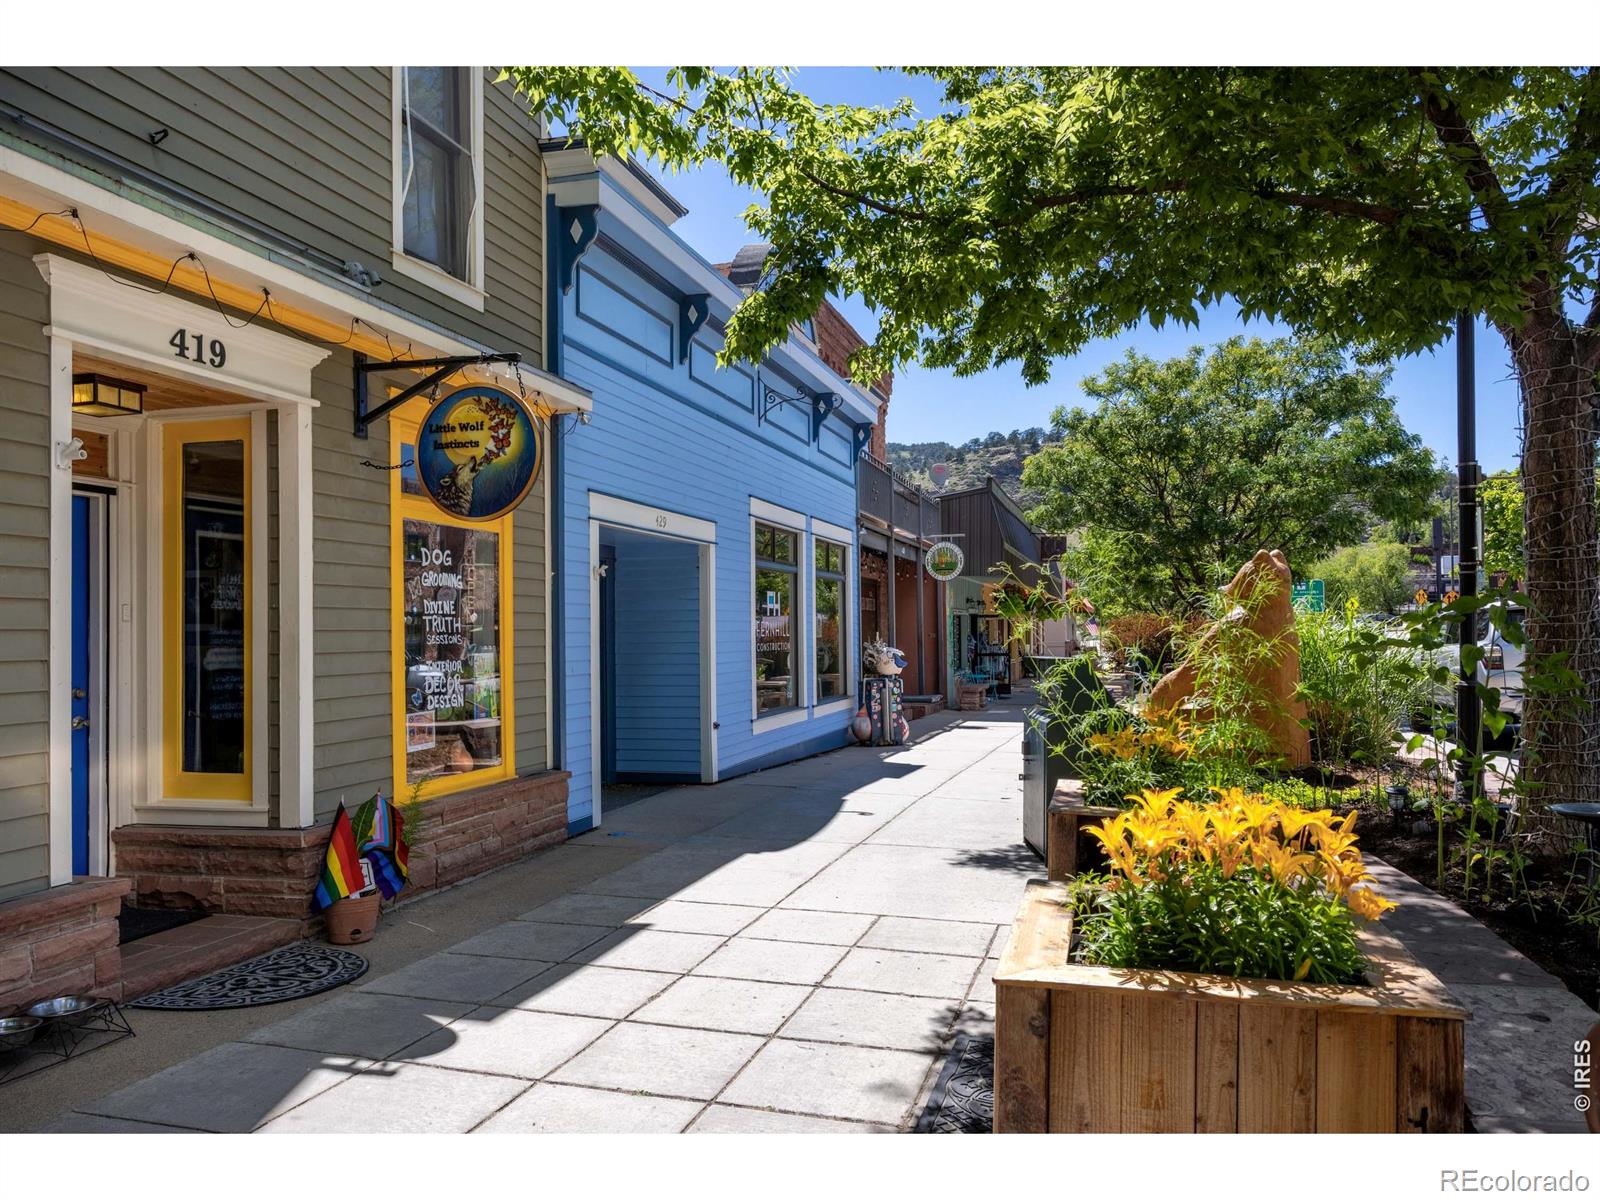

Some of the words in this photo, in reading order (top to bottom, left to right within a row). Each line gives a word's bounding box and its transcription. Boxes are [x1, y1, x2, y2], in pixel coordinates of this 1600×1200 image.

[169, 328, 226, 368] 419
[429, 422, 456, 434] Little
[458, 421, 484, 432] Wolf
[433, 439, 480, 450] Instincts
[656, 515, 667, 528] 429
[421, 547, 452, 567] DOG
[421, 570, 463, 589] GROOMING
[423, 599, 456, 615] DIVINE
[422, 615, 461, 633] TRUTH
[756, 621, 790, 637] FERNHILL
[426, 634, 463, 645] SESSIONS
[756, 642, 790, 652] CONSTRUCTION
[425, 660, 464, 673] INTERIOR
[424, 674, 464, 695] DECOR
[426, 692, 464, 710] DESIGN
